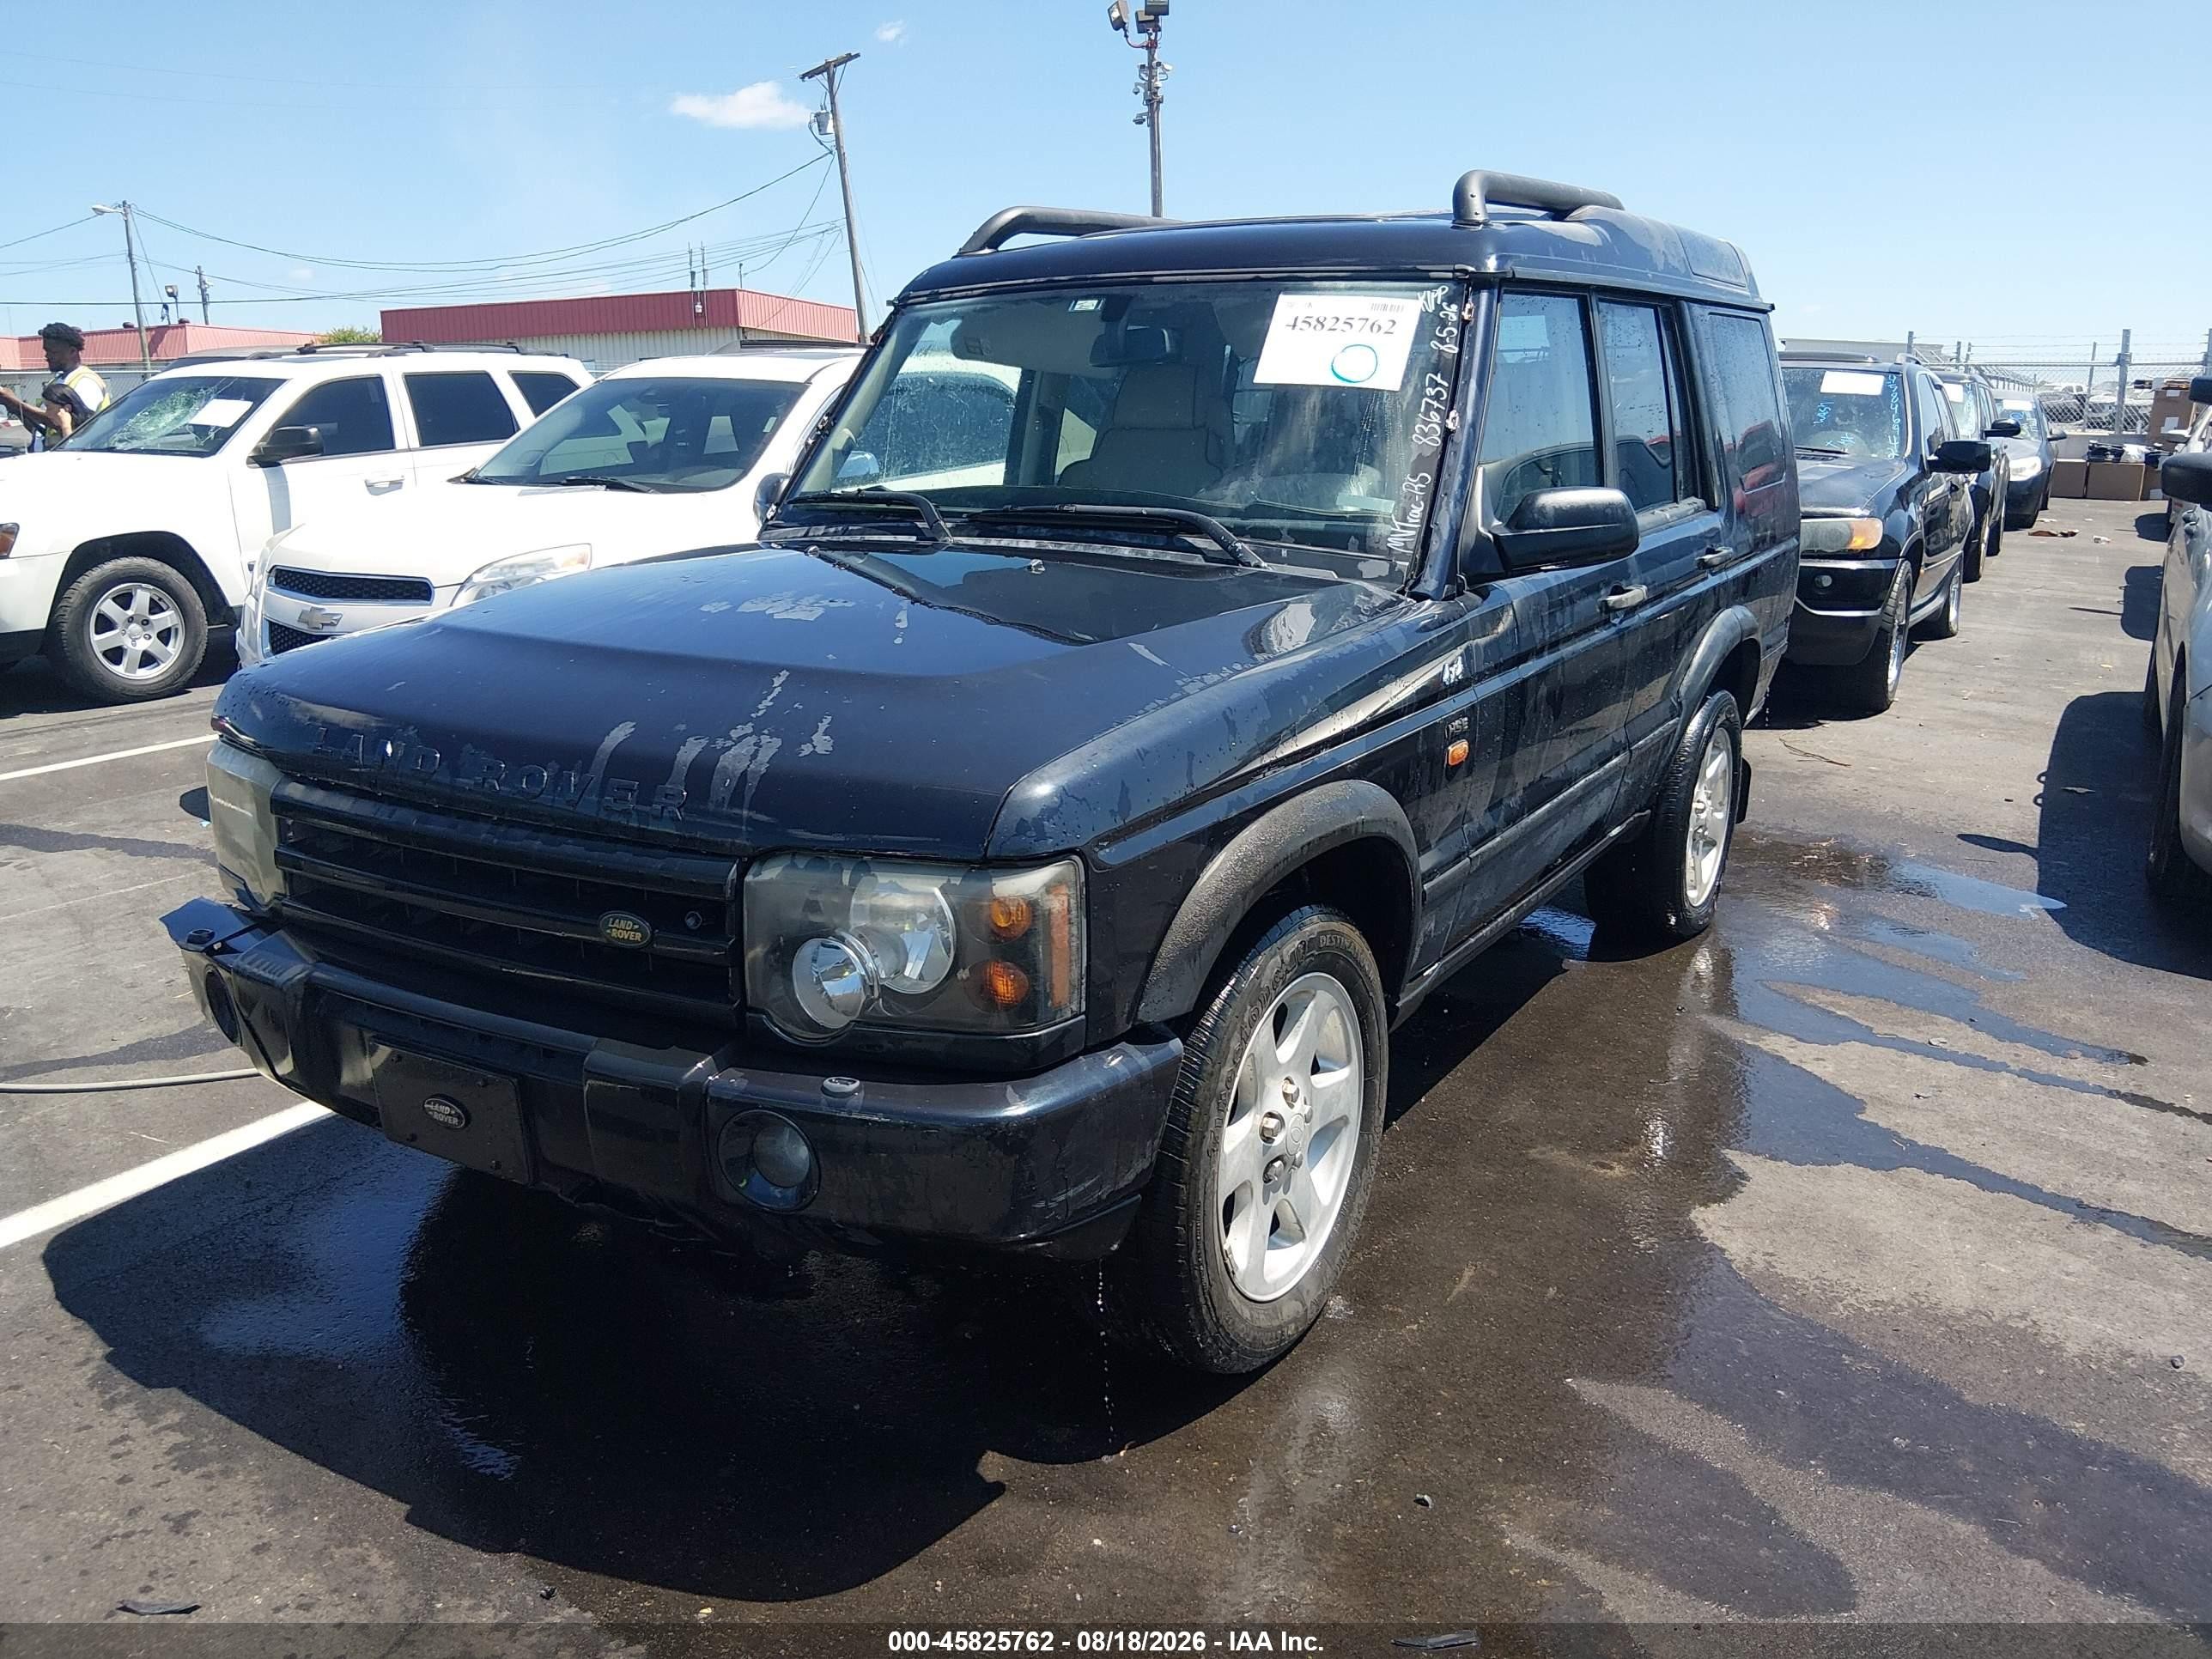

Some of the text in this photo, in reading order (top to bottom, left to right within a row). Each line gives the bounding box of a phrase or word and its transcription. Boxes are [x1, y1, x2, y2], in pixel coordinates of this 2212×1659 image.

[1285, 315, 1397, 335] 45825762
[1430, 301, 1460, 354] 8-5-26
[1413, 372, 1449, 447] 836737
[472, 758, 688, 823] ROVER
[608, 917, 633, 931] LAND
[611, 928, 642, 942] ROVER
[430, 1101, 451, 1115] LAND
[433, 1112, 459, 1126] ROVER
